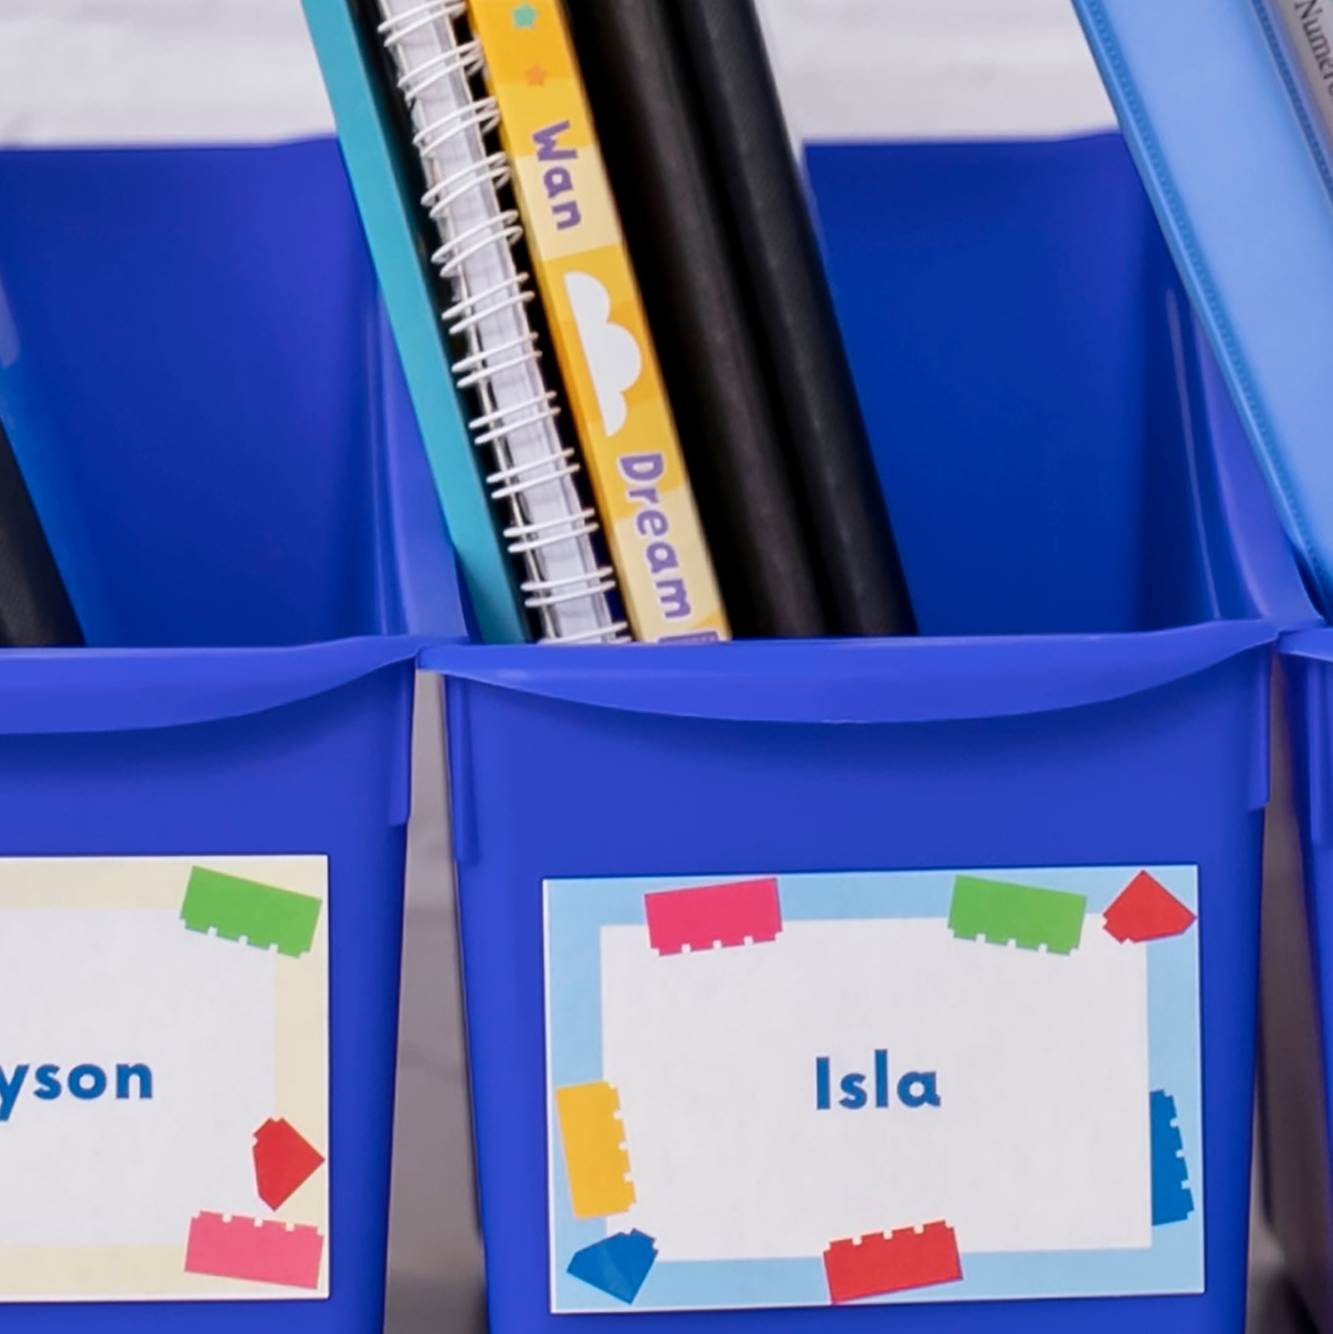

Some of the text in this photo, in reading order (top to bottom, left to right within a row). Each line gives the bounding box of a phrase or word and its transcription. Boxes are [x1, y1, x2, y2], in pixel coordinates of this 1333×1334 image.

[532, 119, 583, 231] Wan
[619, 453, 692, 619] Dream
[815, 1048, 941, 1110] Isla
